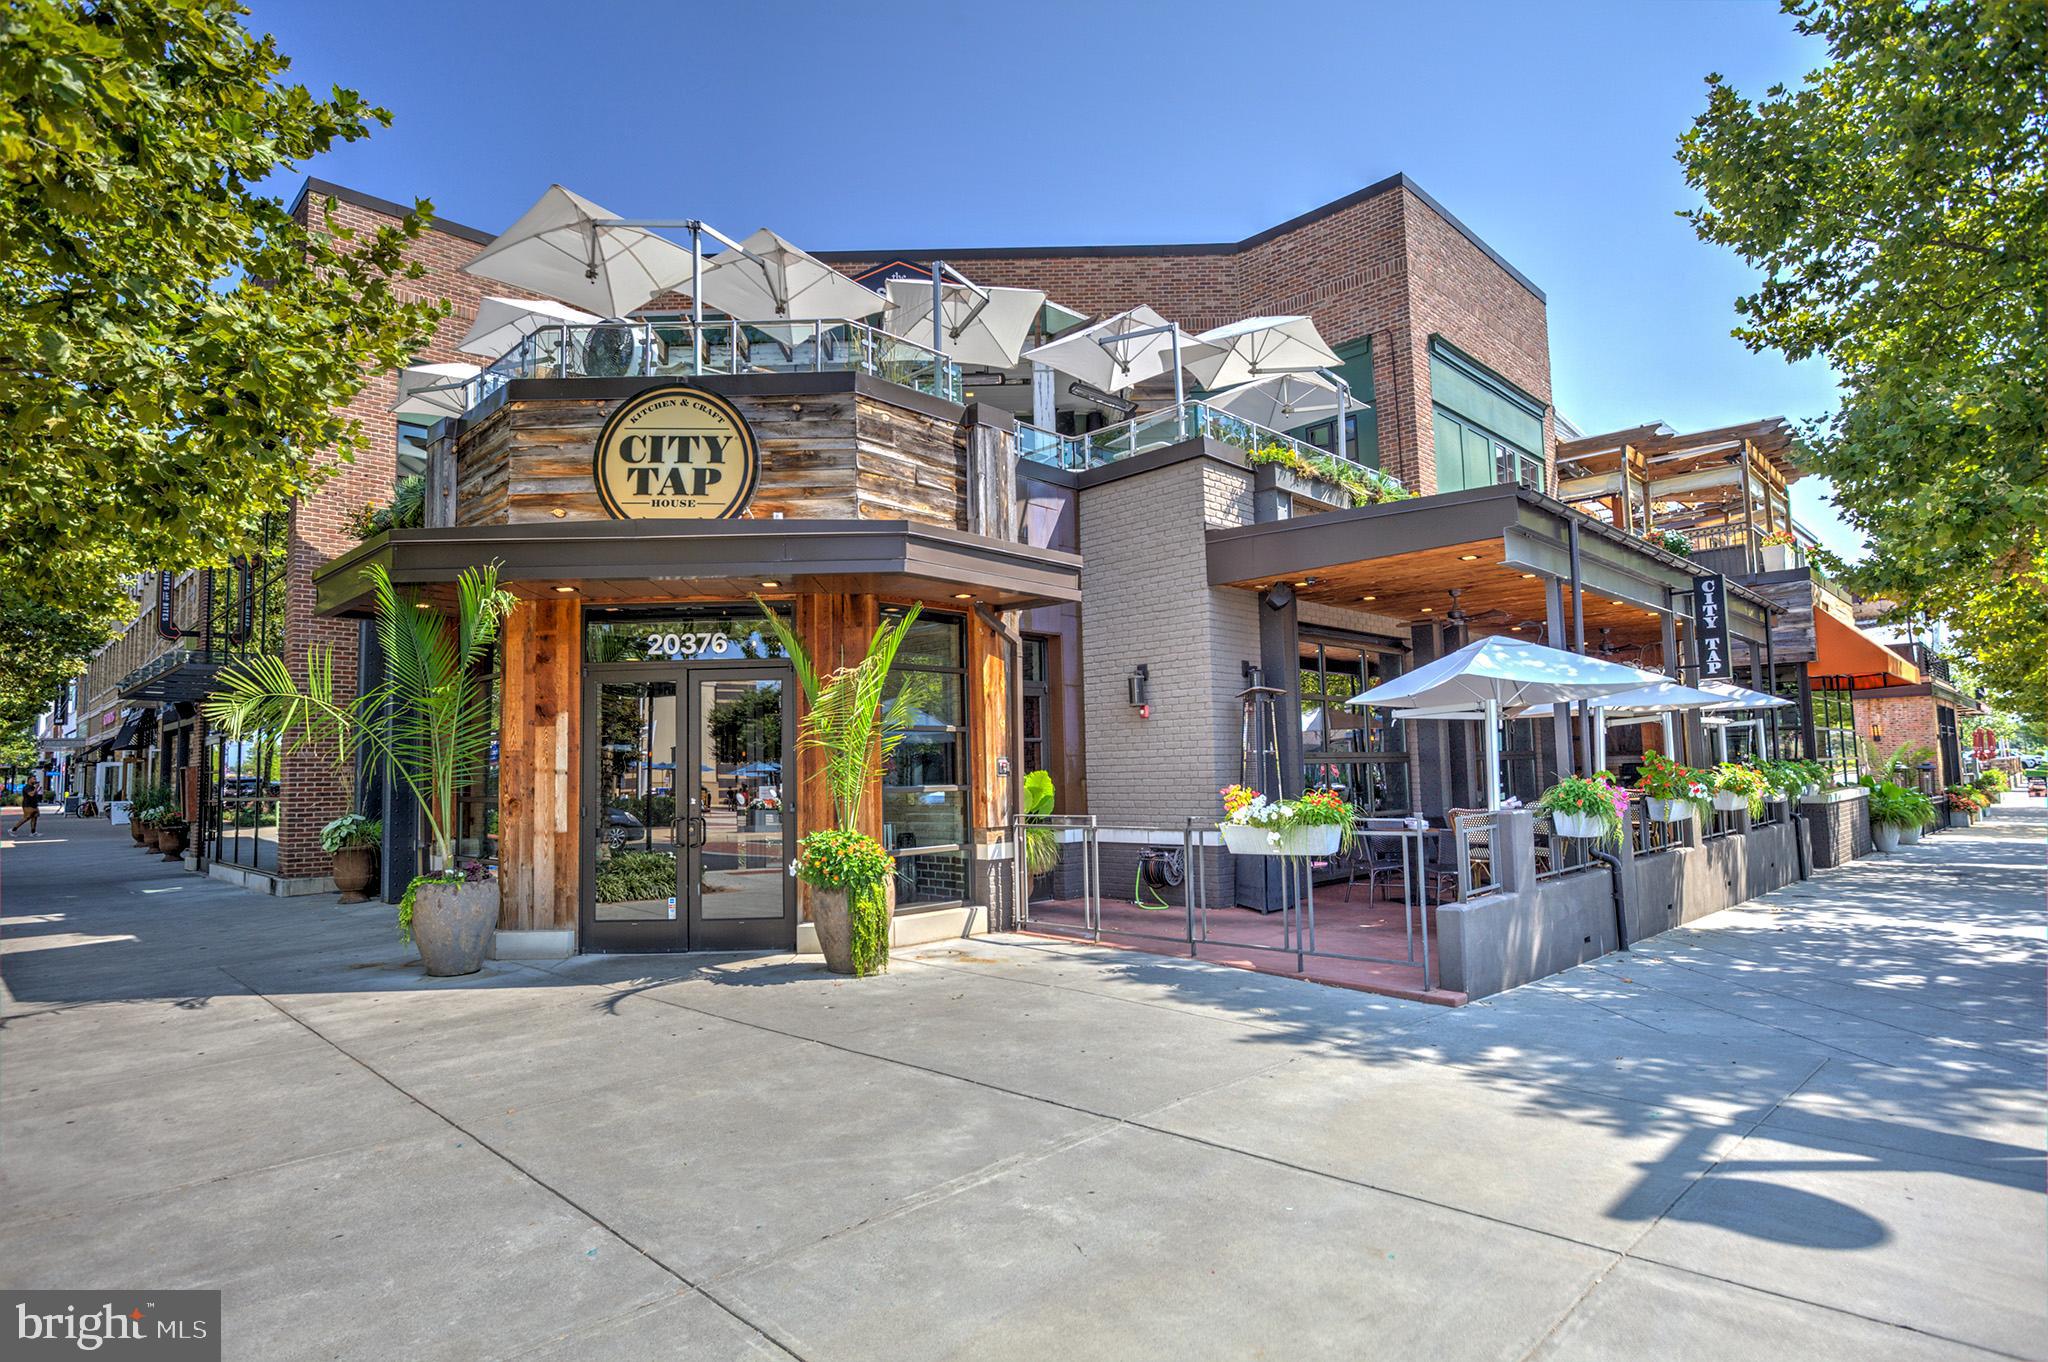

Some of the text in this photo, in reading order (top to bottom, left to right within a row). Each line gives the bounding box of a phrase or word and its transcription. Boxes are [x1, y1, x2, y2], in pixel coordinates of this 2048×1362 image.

[629, 398, 726, 424] KITCHEN & CRAFT
[619, 434, 733, 464] CITY
[626, 467, 722, 497] TAP
[651, 499, 696, 508] HOUSE
[1701, 580, 1722, 674] CITY TAP
[647, 632, 728, 655] 20376
